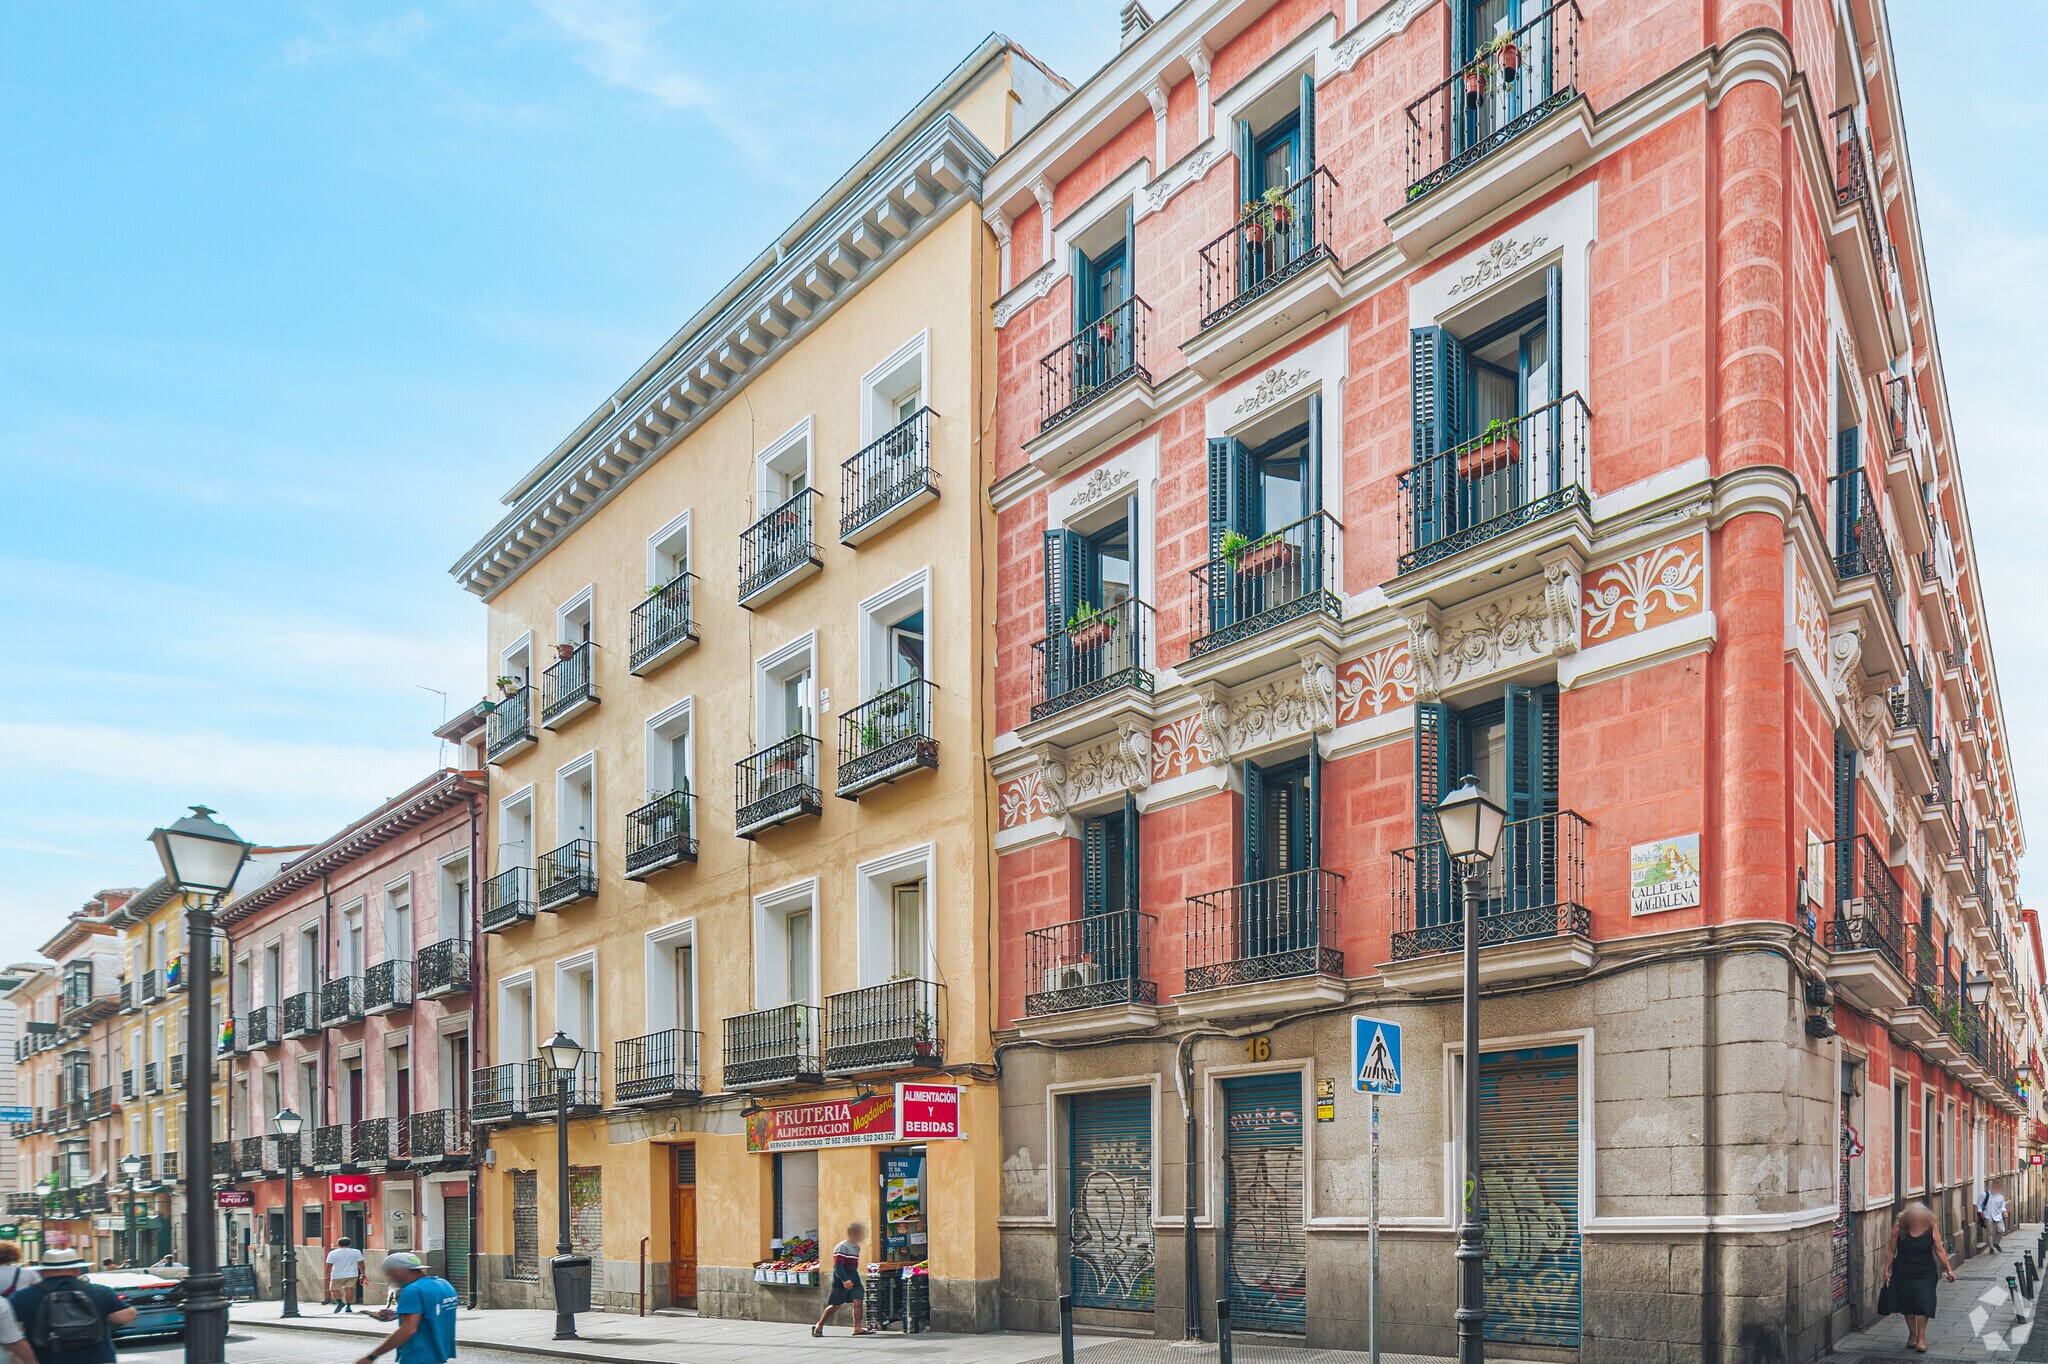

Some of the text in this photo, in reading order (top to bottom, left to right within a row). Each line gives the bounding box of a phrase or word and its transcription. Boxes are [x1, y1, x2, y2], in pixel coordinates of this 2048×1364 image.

[1632, 880, 1698, 899] CALLE DE LA
[1634, 891, 1695, 912] MAGDALENA
[1244, 1037, 1269, 1062] 16
[904, 1090, 956, 1103] ALIMENTACIÓN
[776, 1104, 852, 1126] FRUTERIA
[853, 1098, 894, 1132] Magdalena
[927, 1106, 934, 1117] Y
[777, 1122, 850, 1138] ALIMENTACION
[906, 1120, 954, 1133] BEBIDAS
[770, 1141, 791, 1149] SERVICIO
[797, 1139, 823, 1147] DOMICILIO
[874, 1133, 884, 1141] 243
